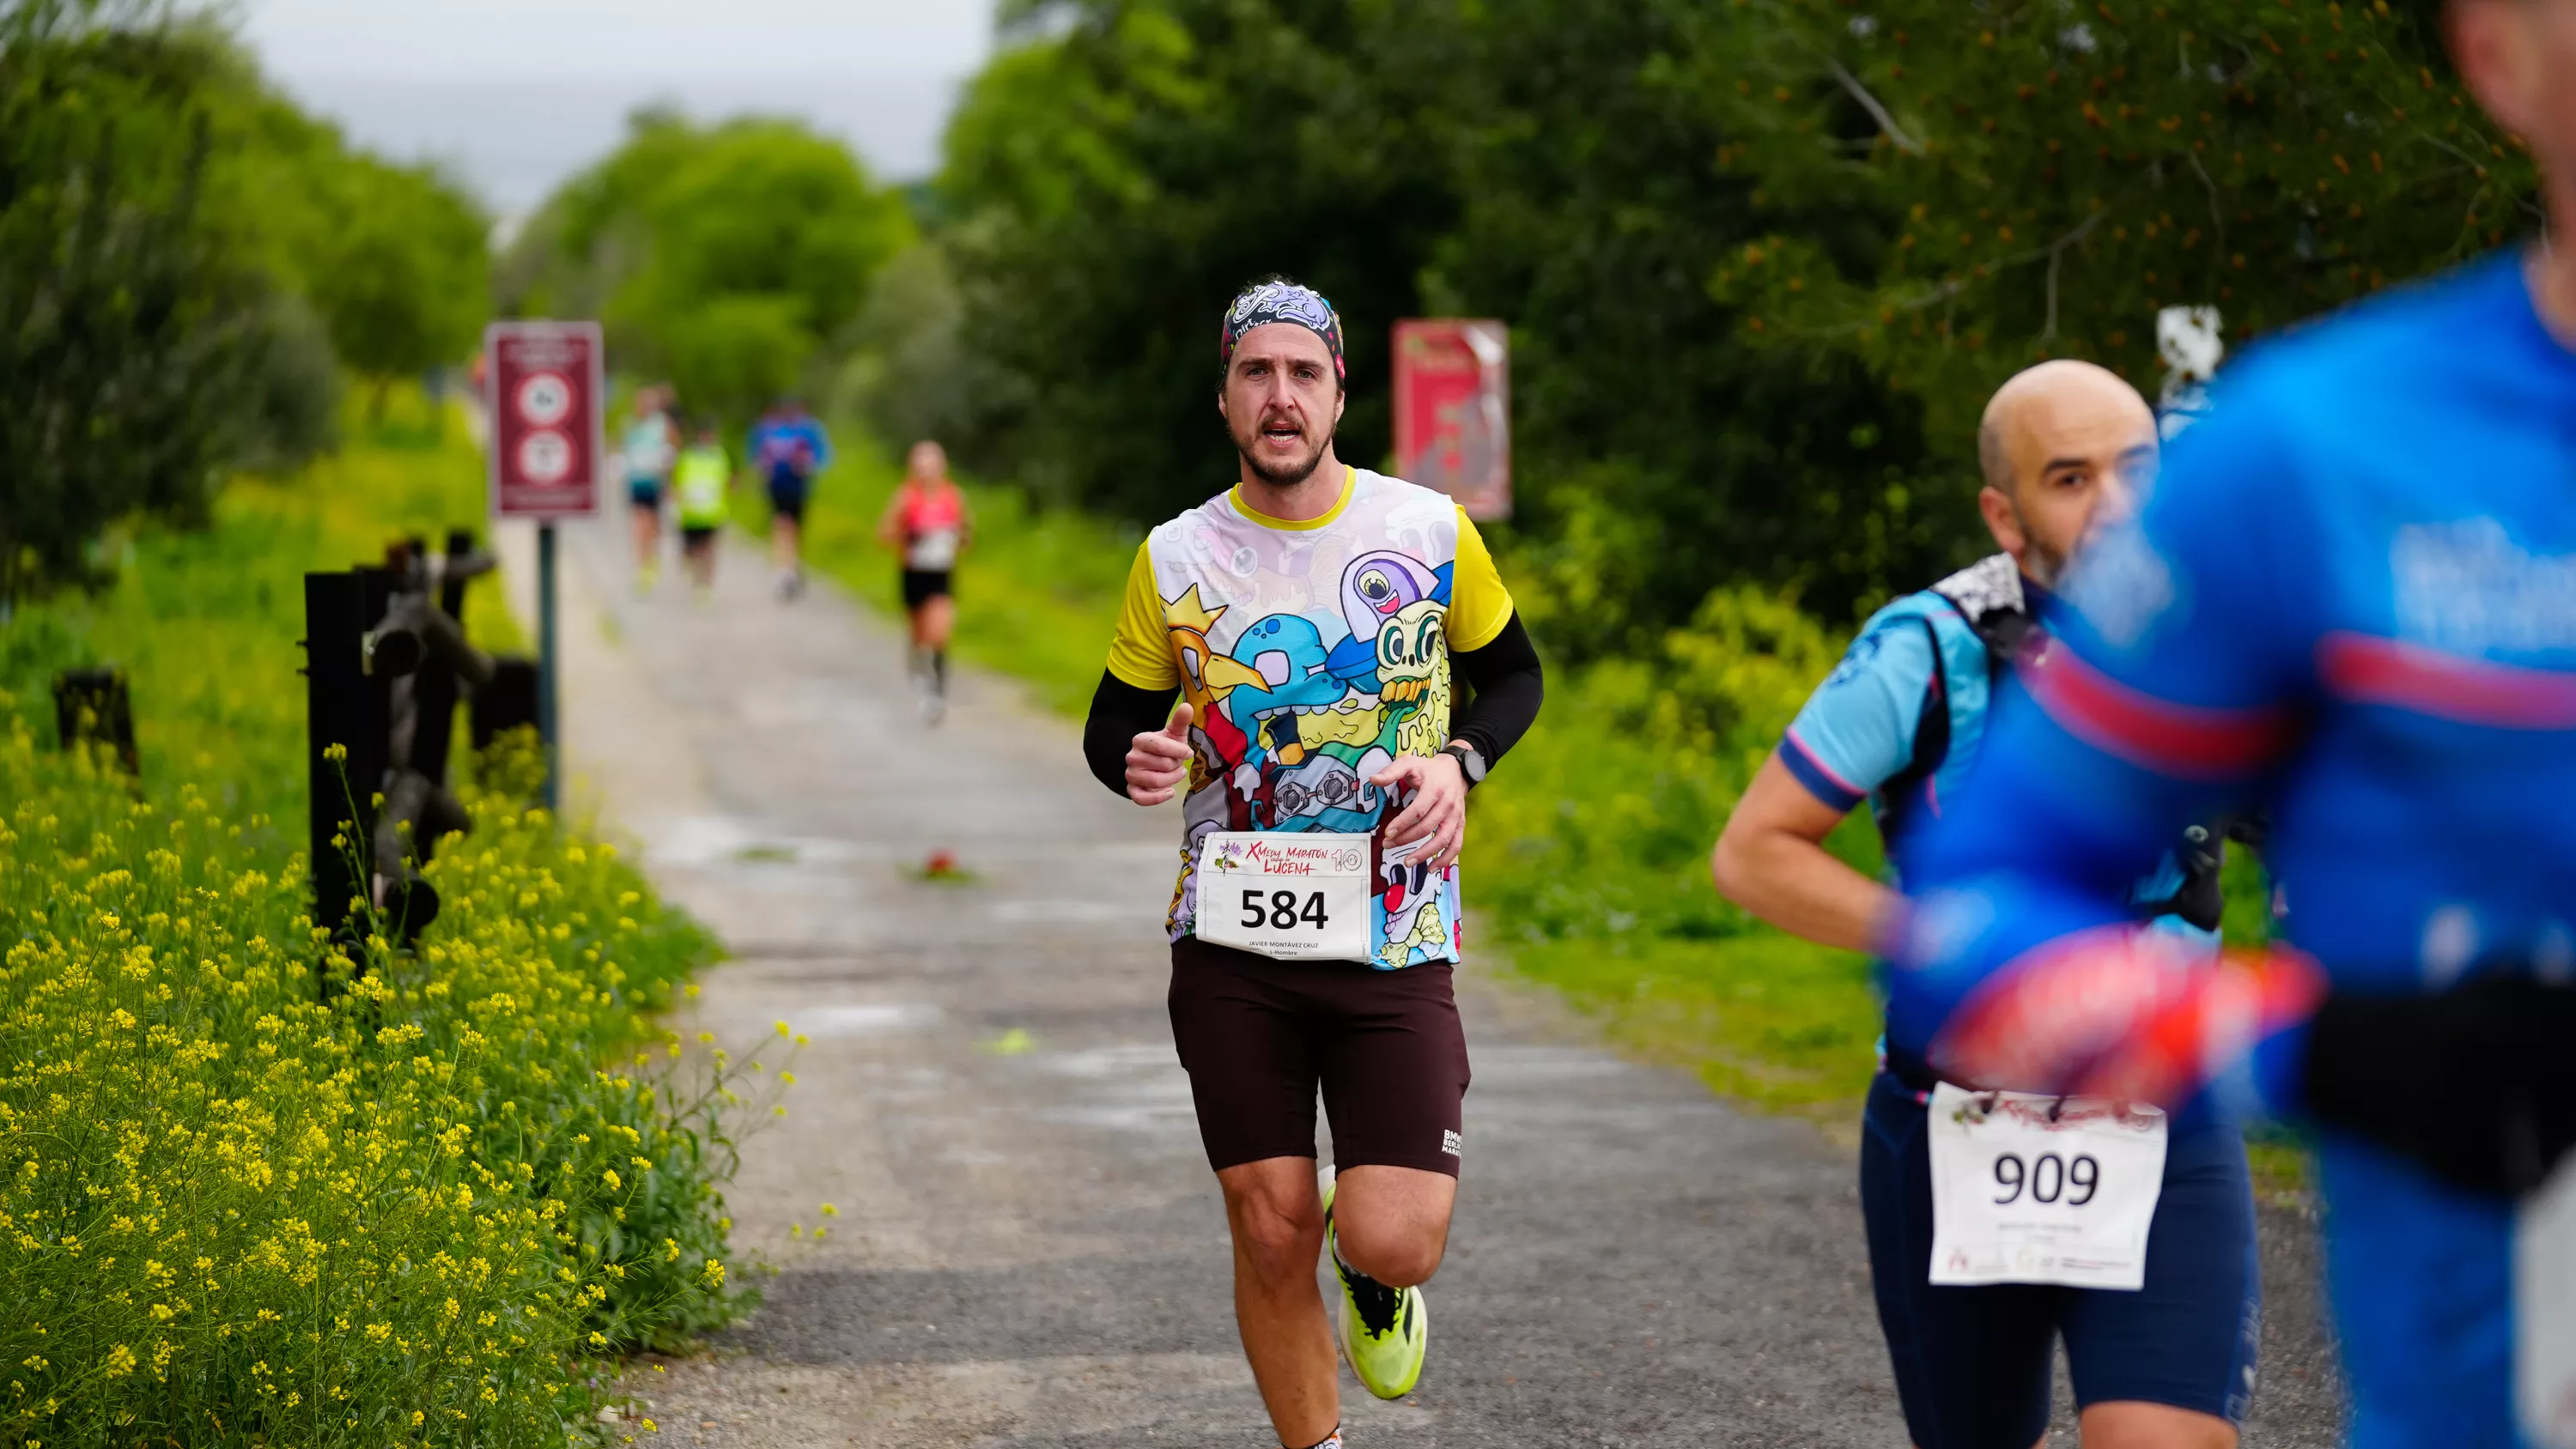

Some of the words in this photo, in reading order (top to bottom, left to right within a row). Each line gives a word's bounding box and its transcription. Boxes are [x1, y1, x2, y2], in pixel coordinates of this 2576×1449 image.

[1264, 858, 1317, 876] LUCENA
[1286, 846, 1328, 859] MARATÓN
[1241, 889, 1328, 930] 584
[1993, 1153, 2100, 1206] 909
